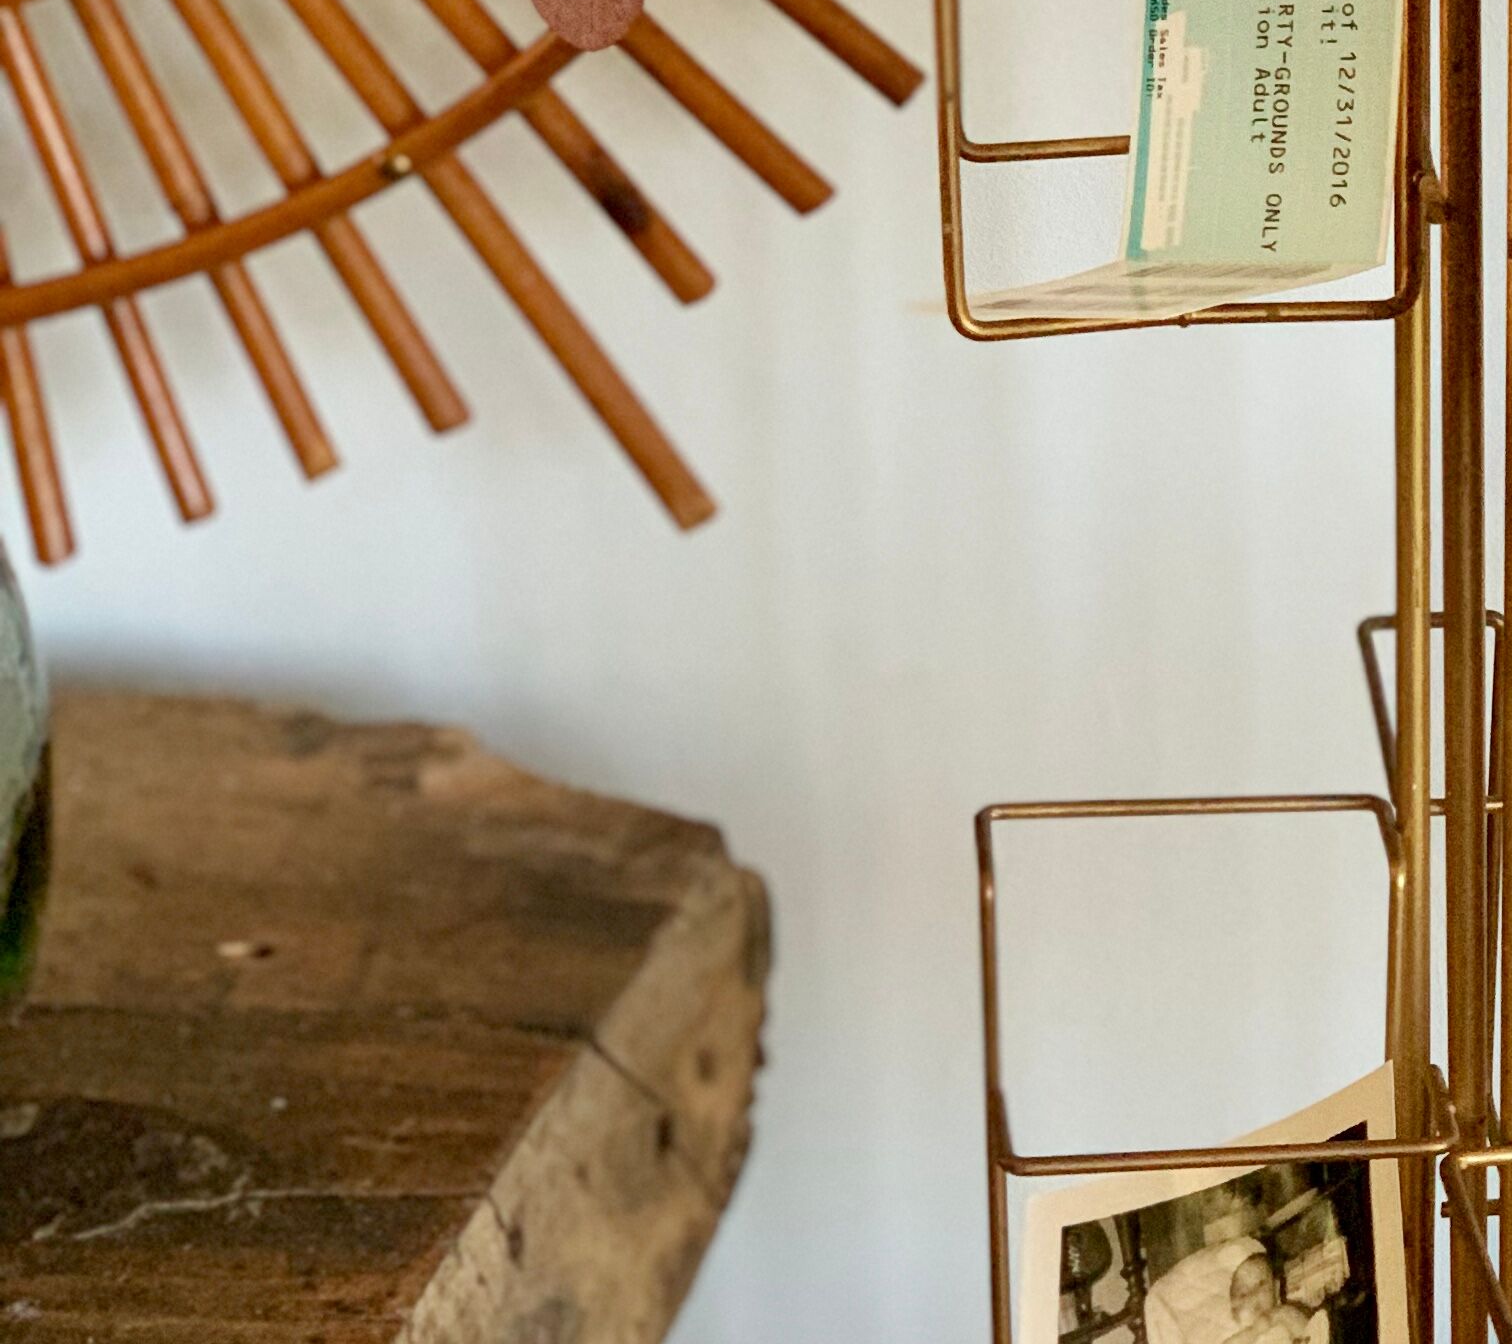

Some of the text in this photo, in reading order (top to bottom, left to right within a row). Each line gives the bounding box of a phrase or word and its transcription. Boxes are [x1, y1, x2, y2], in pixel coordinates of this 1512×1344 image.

[1341, 3, 1358, 31] of
[1158, 28, 1169, 68] Sales
[1250, 67, 1271, 144] Adult
[1329, 51, 1357, 208] 12/31/2016
[1261, 193, 1282, 253] ONLY
